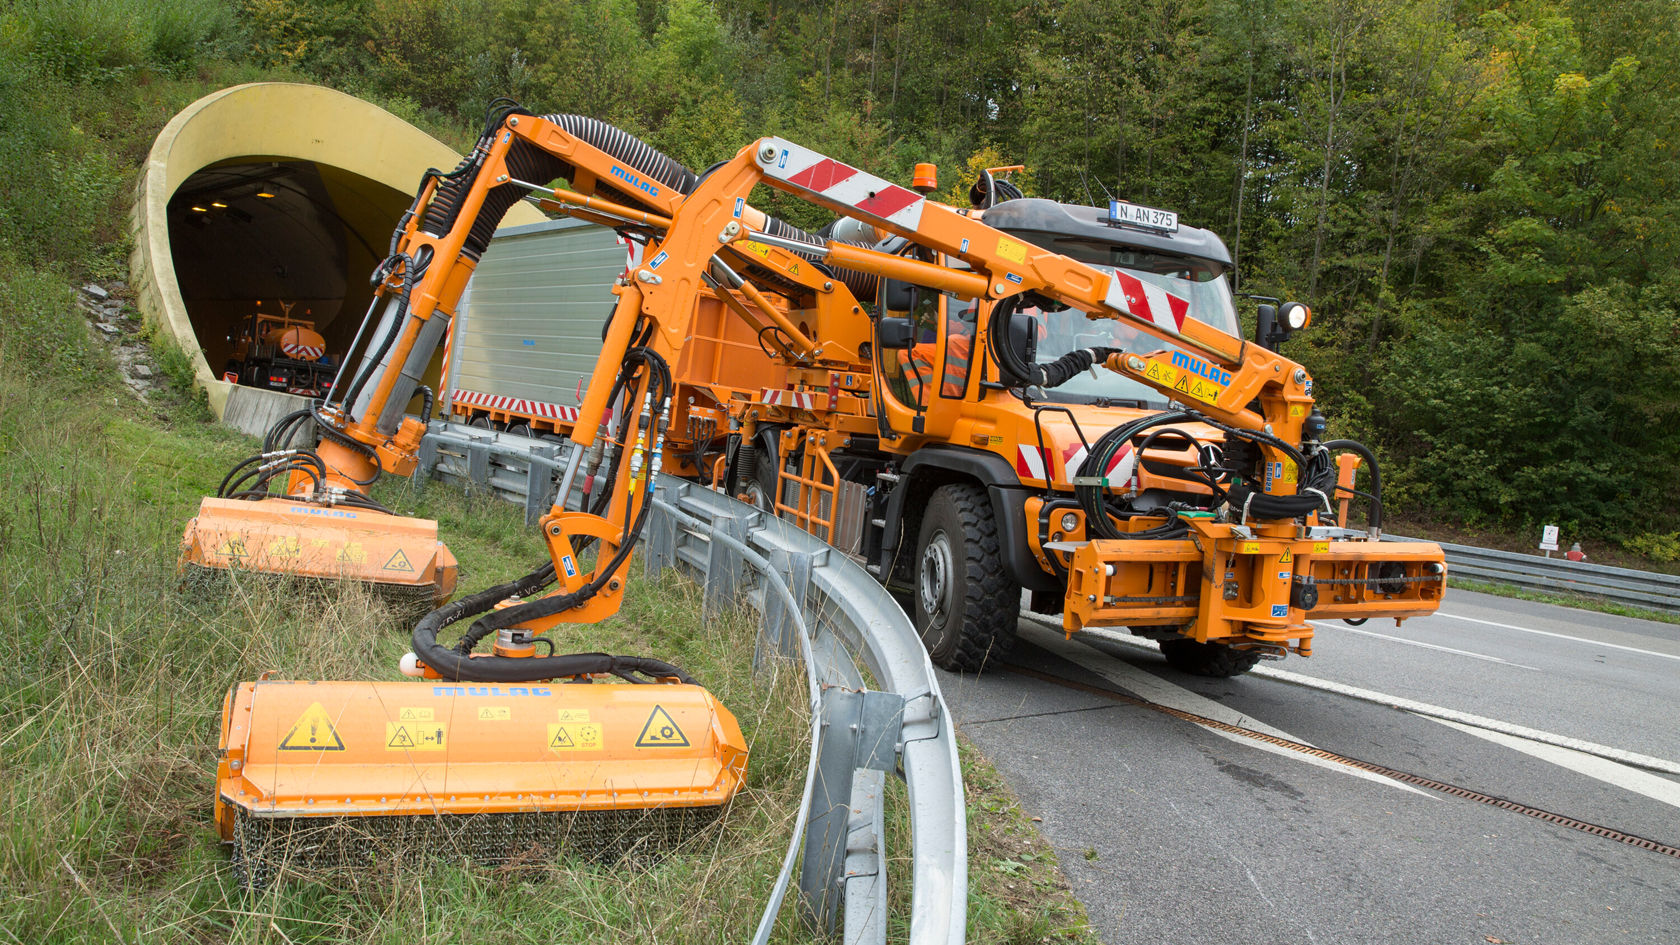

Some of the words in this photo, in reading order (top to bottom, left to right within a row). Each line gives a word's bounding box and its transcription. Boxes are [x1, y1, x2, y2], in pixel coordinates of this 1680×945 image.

[610, 165, 659, 197] MULAG
[1120, 205, 1128, 219] N
[1135, 208, 1150, 223] AN
[1152, 211, 1173, 227] 375
[1171, 351, 1231, 387] MULAG
[290, 506, 357, 519] MULAG
[433, 686, 552, 697] MULAG
